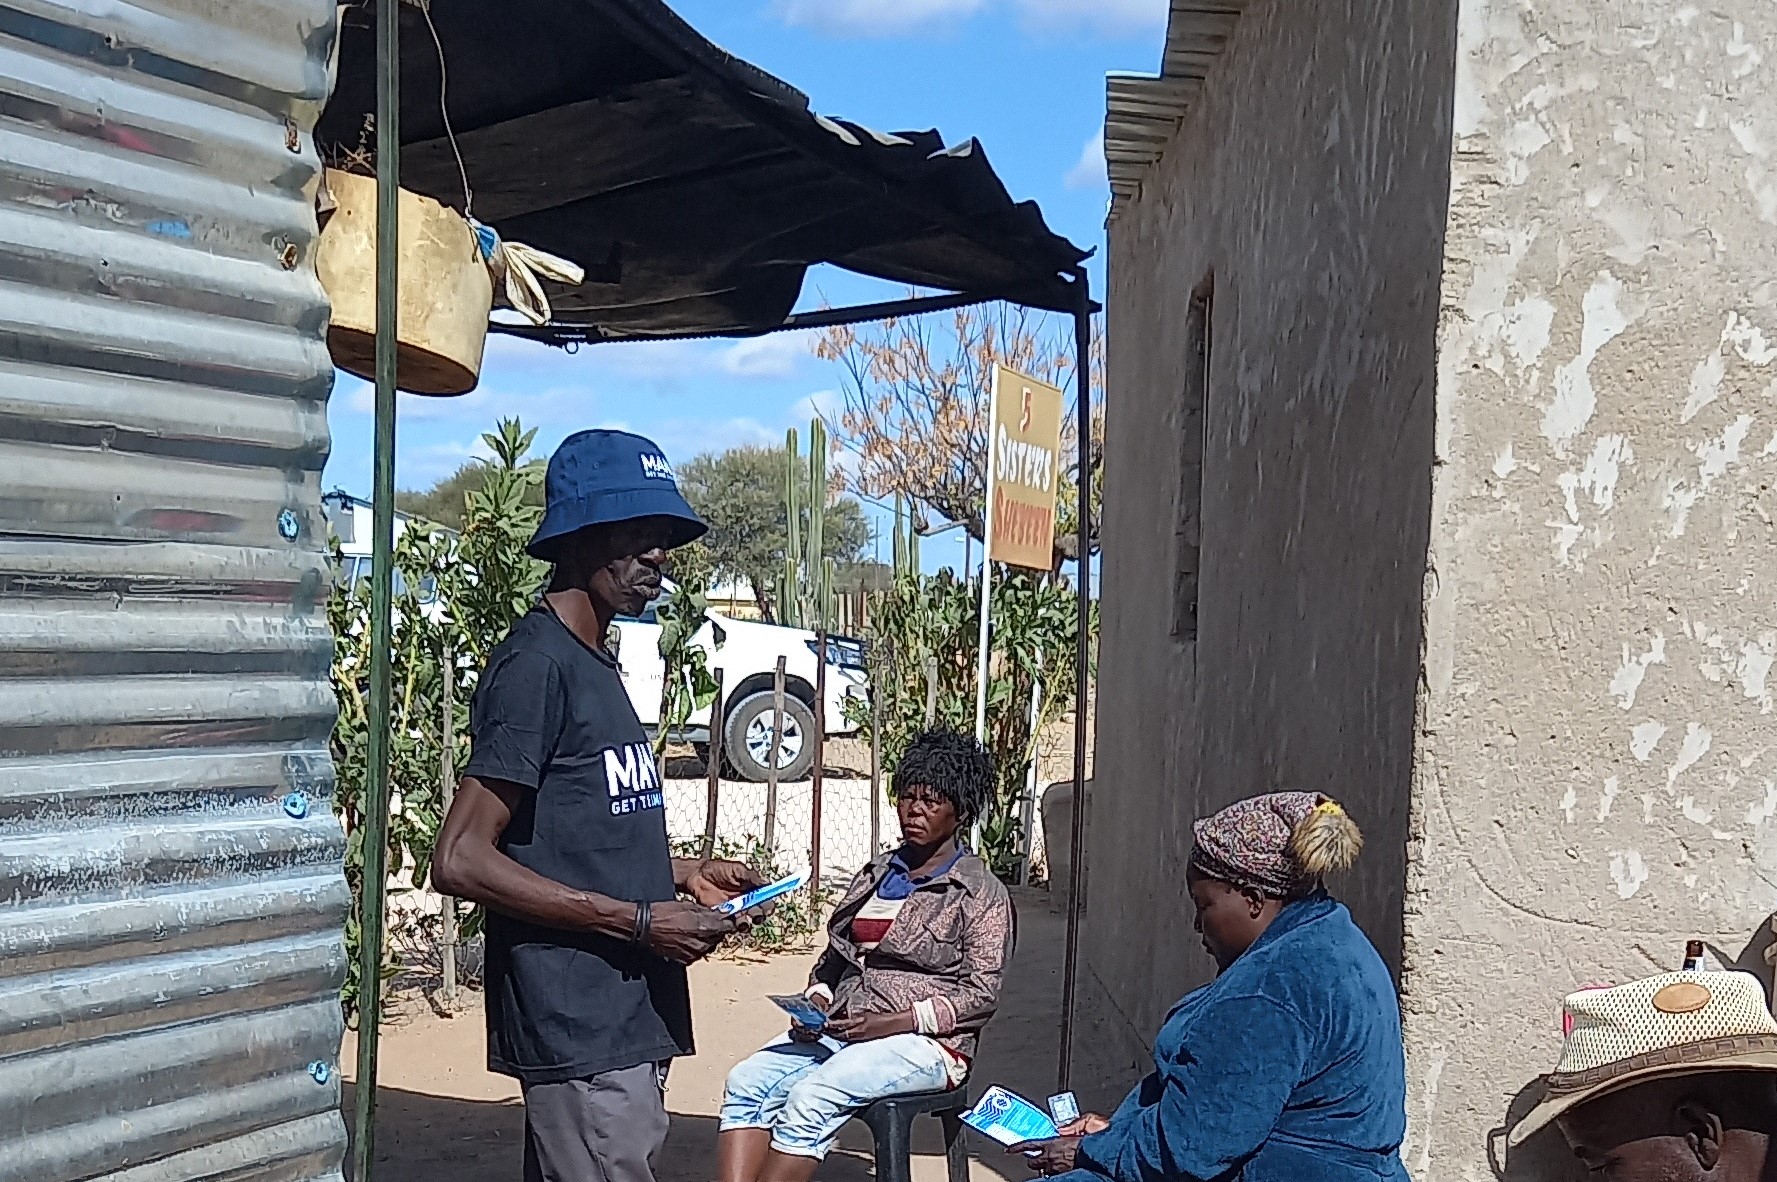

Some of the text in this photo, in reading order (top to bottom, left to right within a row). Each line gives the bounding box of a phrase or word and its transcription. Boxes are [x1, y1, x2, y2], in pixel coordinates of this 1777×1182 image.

[1019, 387, 1032, 434] 5
[997, 422, 1051, 493] SISTERS
[611, 797, 637, 815] GET
